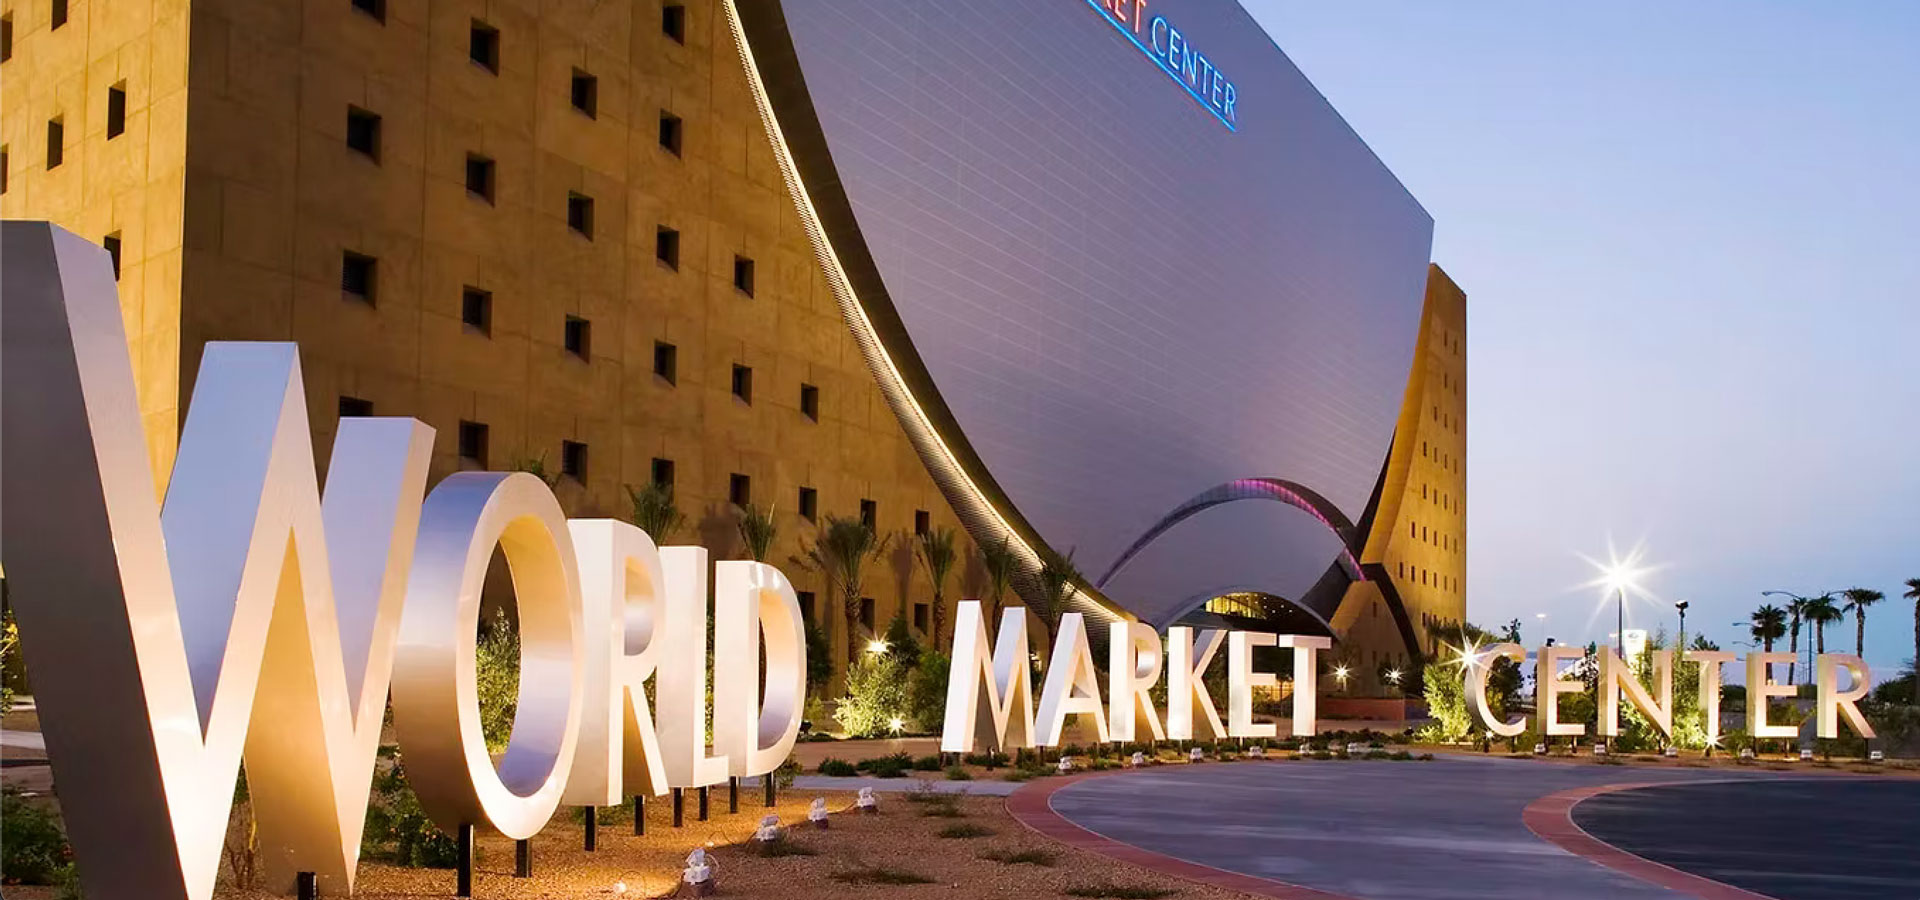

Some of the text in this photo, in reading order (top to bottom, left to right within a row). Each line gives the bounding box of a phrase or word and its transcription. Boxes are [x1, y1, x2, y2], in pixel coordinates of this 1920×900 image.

[1151, 16, 1236, 121] CENTER
[0, 220, 1876, 900] WORLD MARKET CENTER
